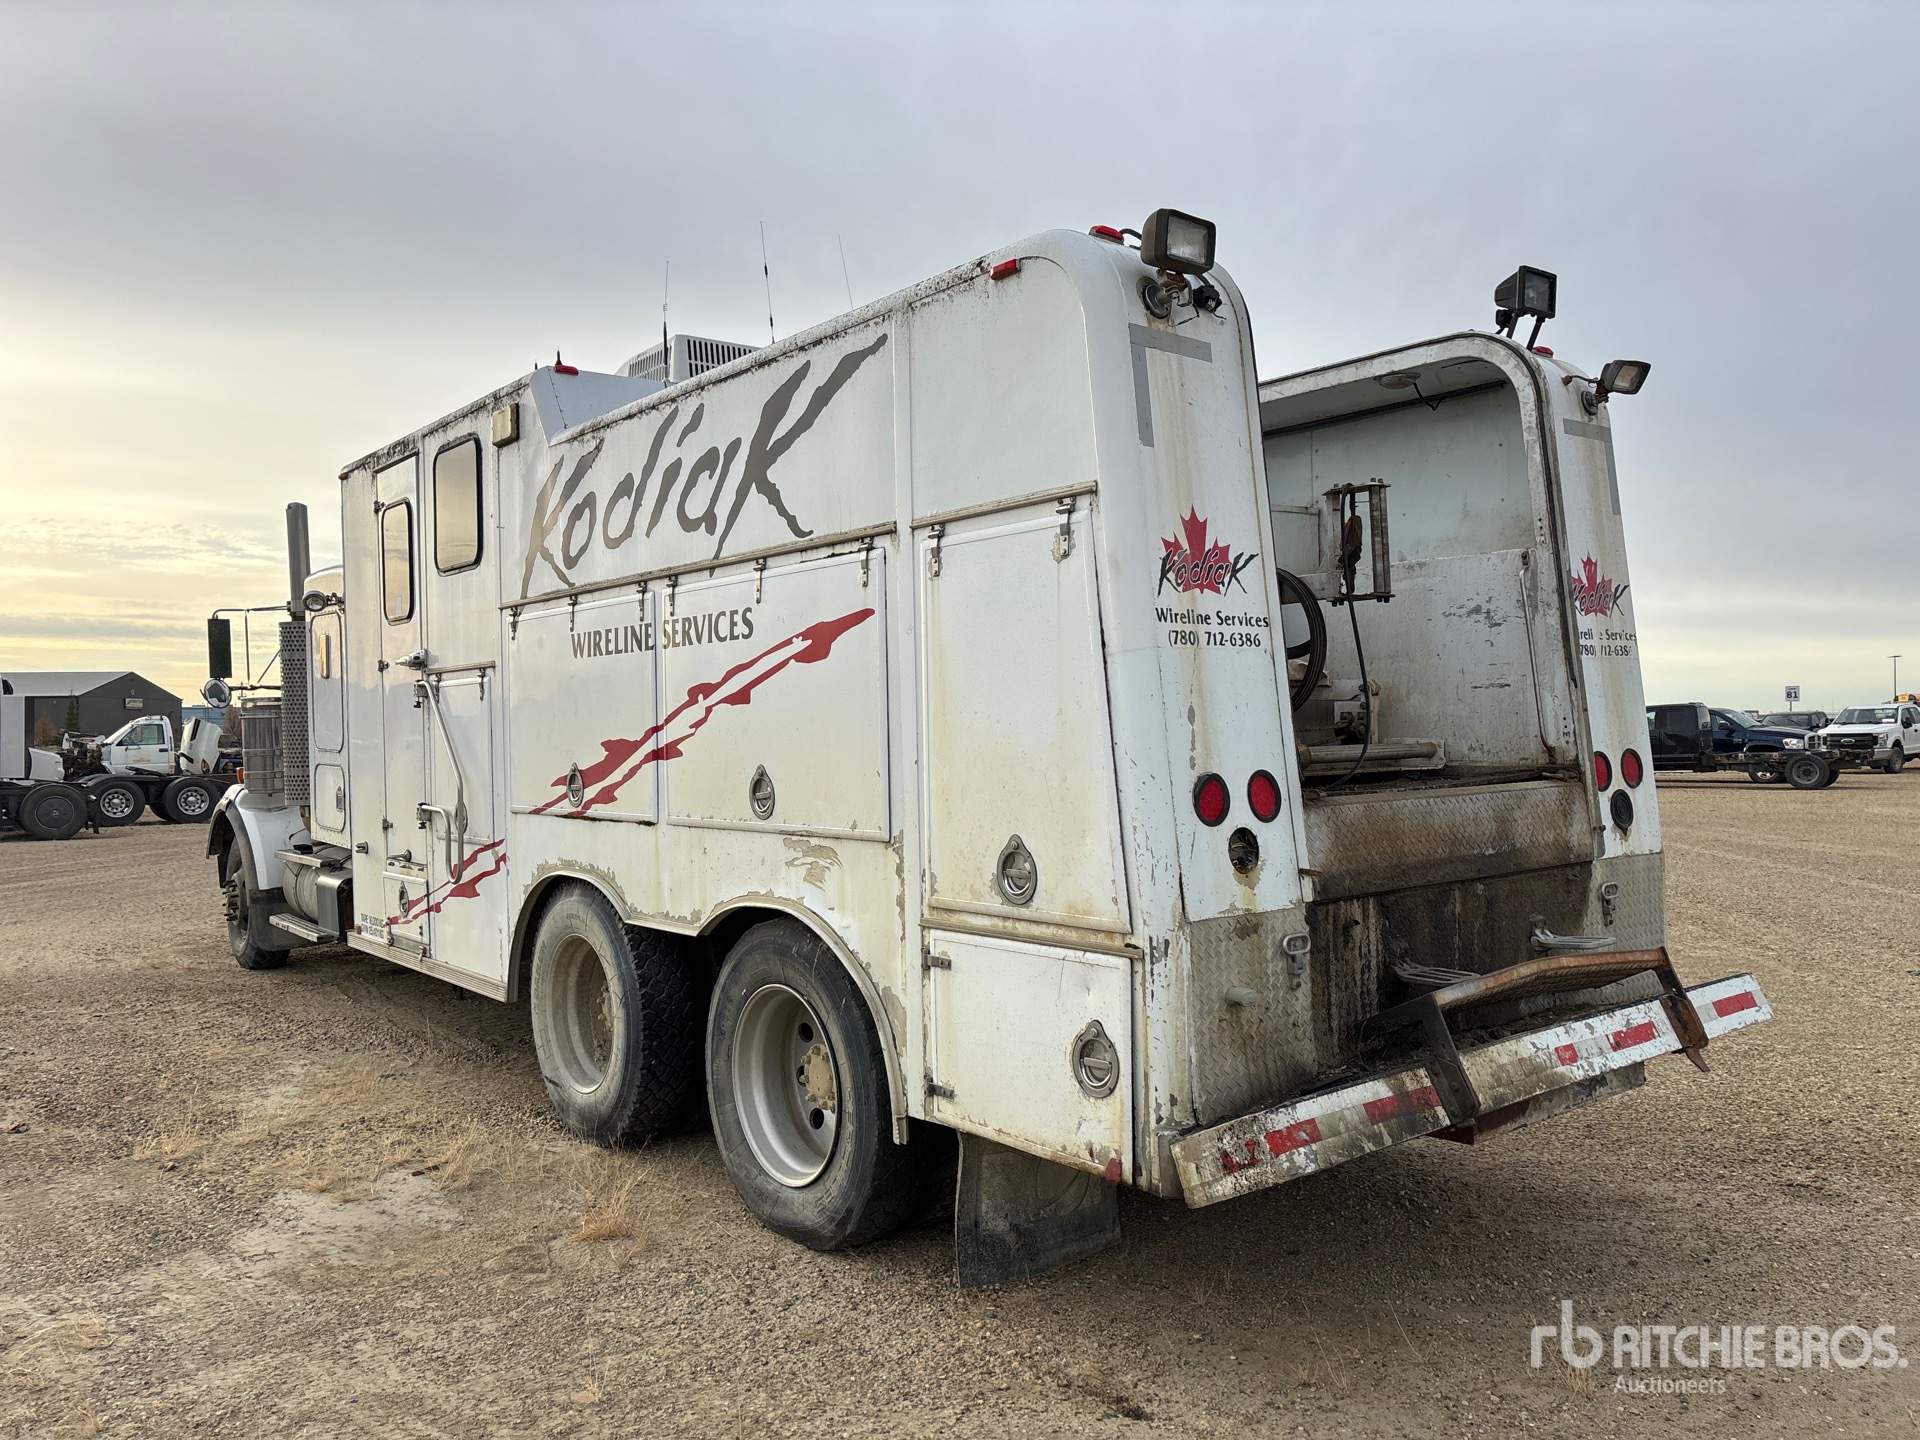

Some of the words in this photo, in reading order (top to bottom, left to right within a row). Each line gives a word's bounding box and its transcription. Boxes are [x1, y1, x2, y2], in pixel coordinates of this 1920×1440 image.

[1155, 607, 1212, 626] Wireline
[1216, 610, 1269, 628] Services
[570, 621, 655, 660] WIRELINE
[661, 606, 754, 649] SERVICES
[1168, 629, 1200, 648] (780)
[1205, 631, 1262, 648] 712-6386
[1786, 691, 1798, 699] 81
